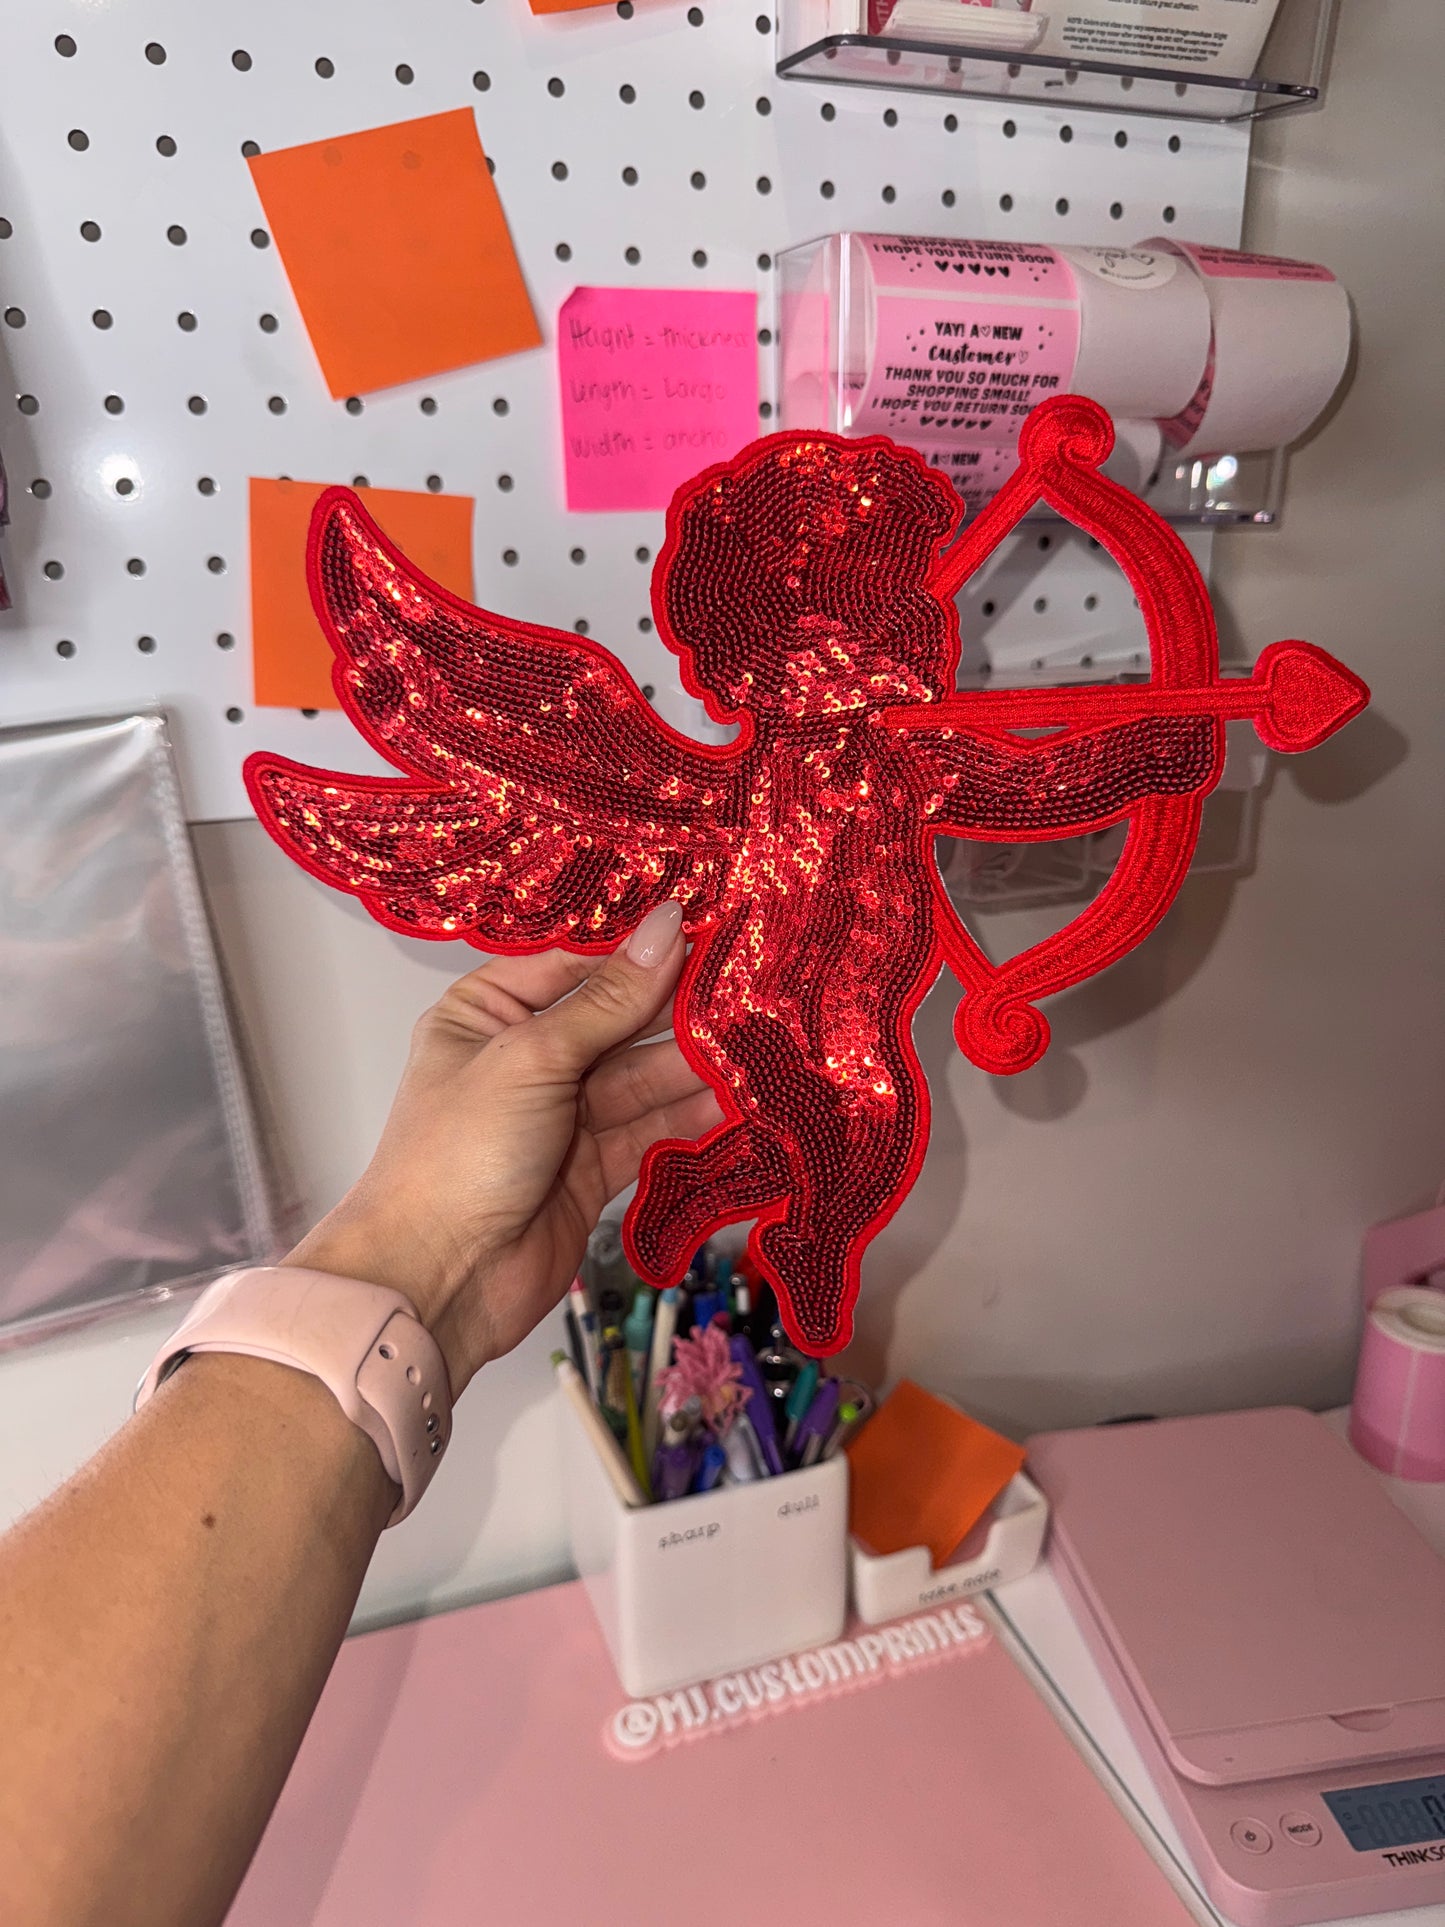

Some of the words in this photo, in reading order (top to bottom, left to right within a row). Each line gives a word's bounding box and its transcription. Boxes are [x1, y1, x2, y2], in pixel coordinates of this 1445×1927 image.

[873, 244, 879, 252] I
[882, 244, 922, 256] HOPE
[925, 248, 954, 258] YOU
[960, 249, 1014, 262] RETURN
[1017, 254, 1055, 265] SOON
[935, 322, 965, 337] YAY!
[970, 324, 979, 338] A
[992, 326, 1023, 341] NEW
[885, 367, 932, 382] THANK
[936, 369, 965, 383] YOU
[967, 371, 985, 385] SO
[989, 372, 1030, 387] MUCH
[1032, 375, 1060, 388] FOR
[906, 384, 979, 399] SHOPPING
[982, 387, 1030, 402] SMALL!
[872, 398, 878, 409] I
[881, 397, 918, 411] HOPE
[922, 399, 950, 412] YOU
[953, 401, 1008, 415] RETURN
[951, 452, 980, 466] NEW
[1287, 1822, 1314, 1835] MODE
